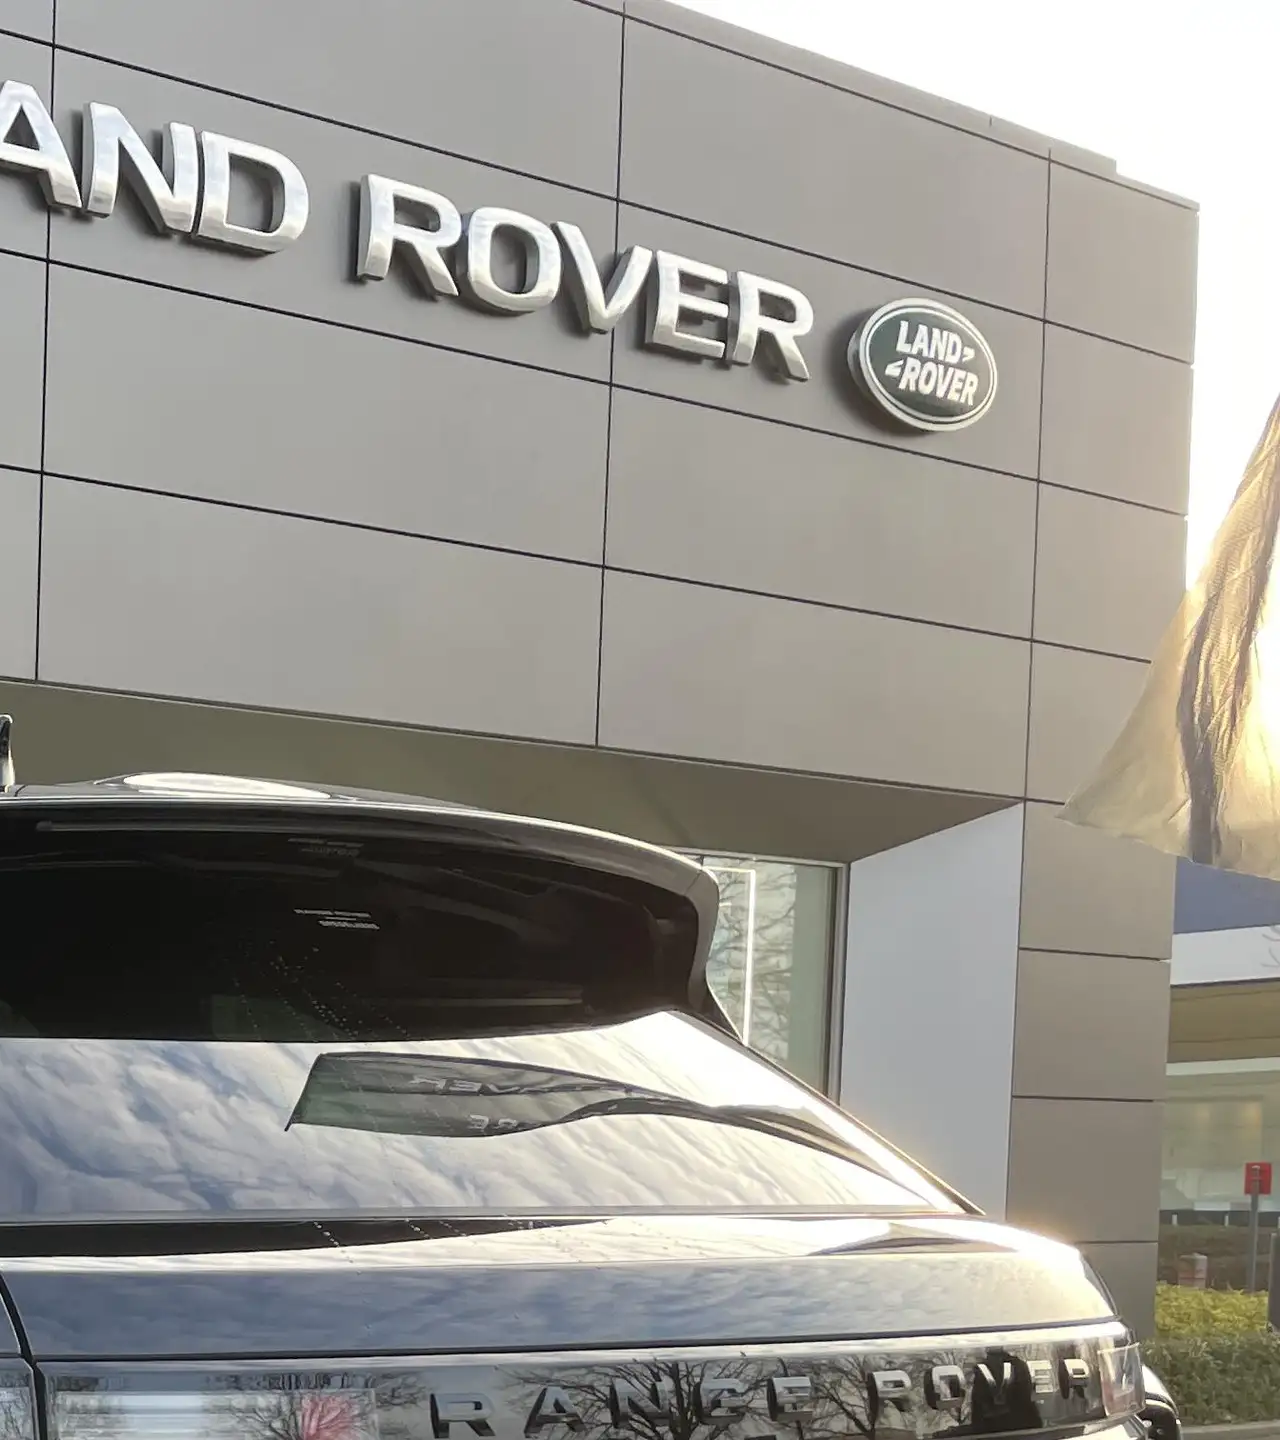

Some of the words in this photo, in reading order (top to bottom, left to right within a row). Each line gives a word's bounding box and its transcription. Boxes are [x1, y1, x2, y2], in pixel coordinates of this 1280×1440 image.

[355, 174, 815, 380] ROVER
[896, 320, 962, 364] LAND
[899, 356, 979, 406] ROVER
[430, 1374, 816, 1439] RANGE
[866, 1357, 1091, 1412] ROVER
